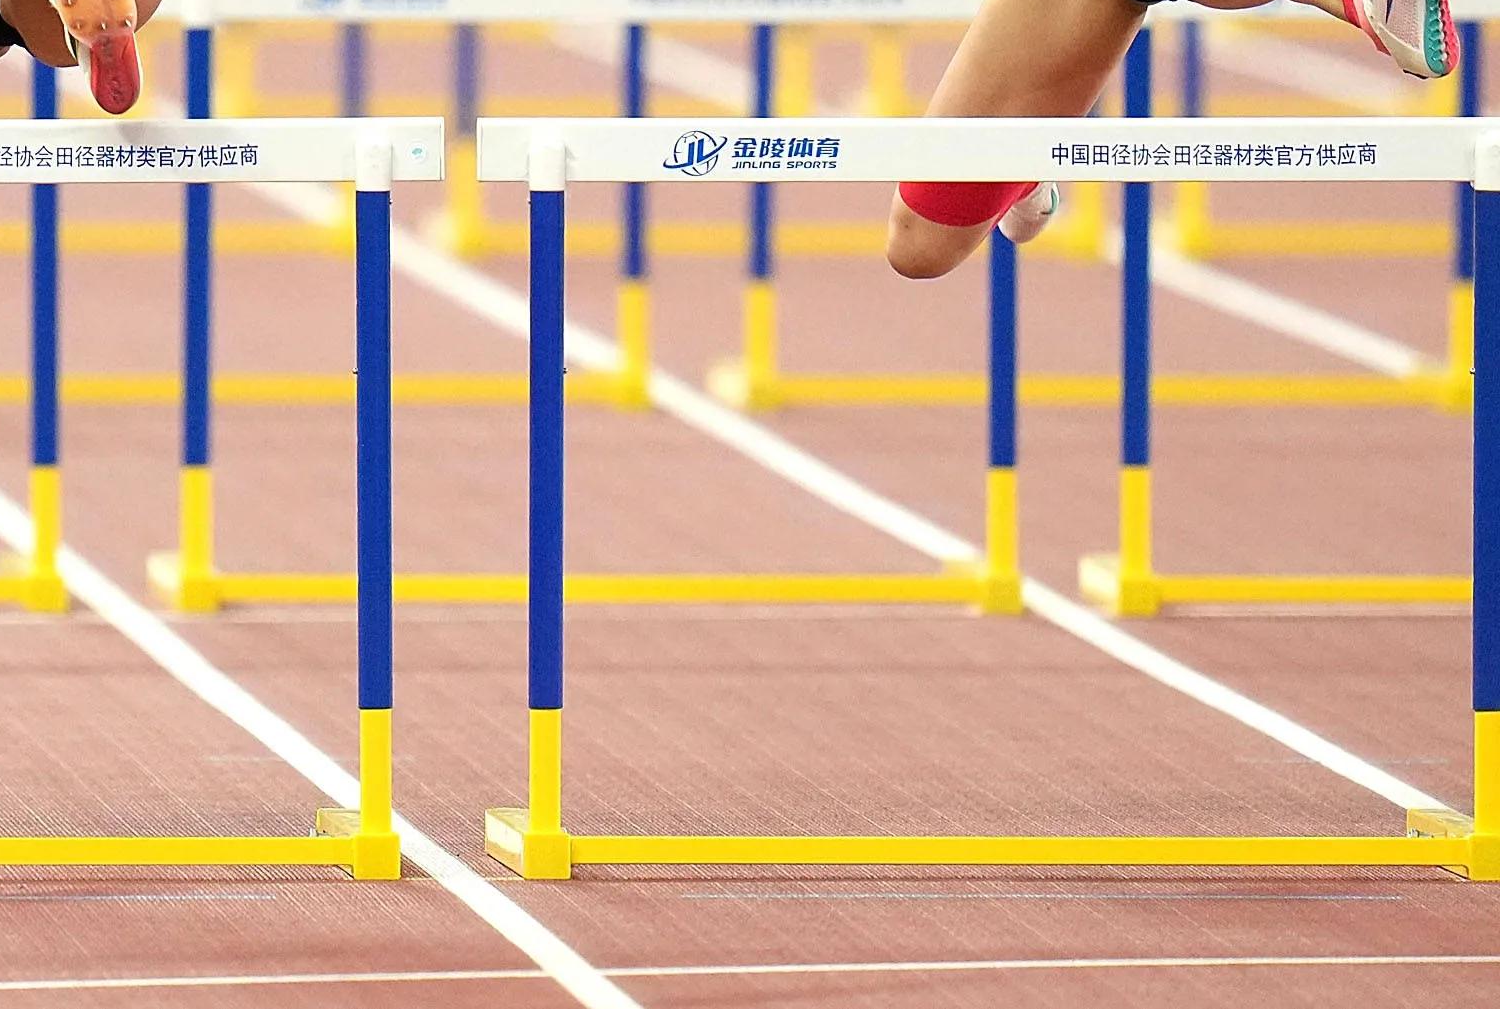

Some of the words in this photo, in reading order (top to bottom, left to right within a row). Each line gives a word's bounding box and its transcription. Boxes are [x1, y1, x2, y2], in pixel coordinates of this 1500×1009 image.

[731, 137, 841, 158] 金陵体育
[1051, 142, 1377, 167] 中国田径协会田径器材类官方供应商
[731, 161, 781, 169] JINLING
[786, 161, 837, 169] SPORTS
